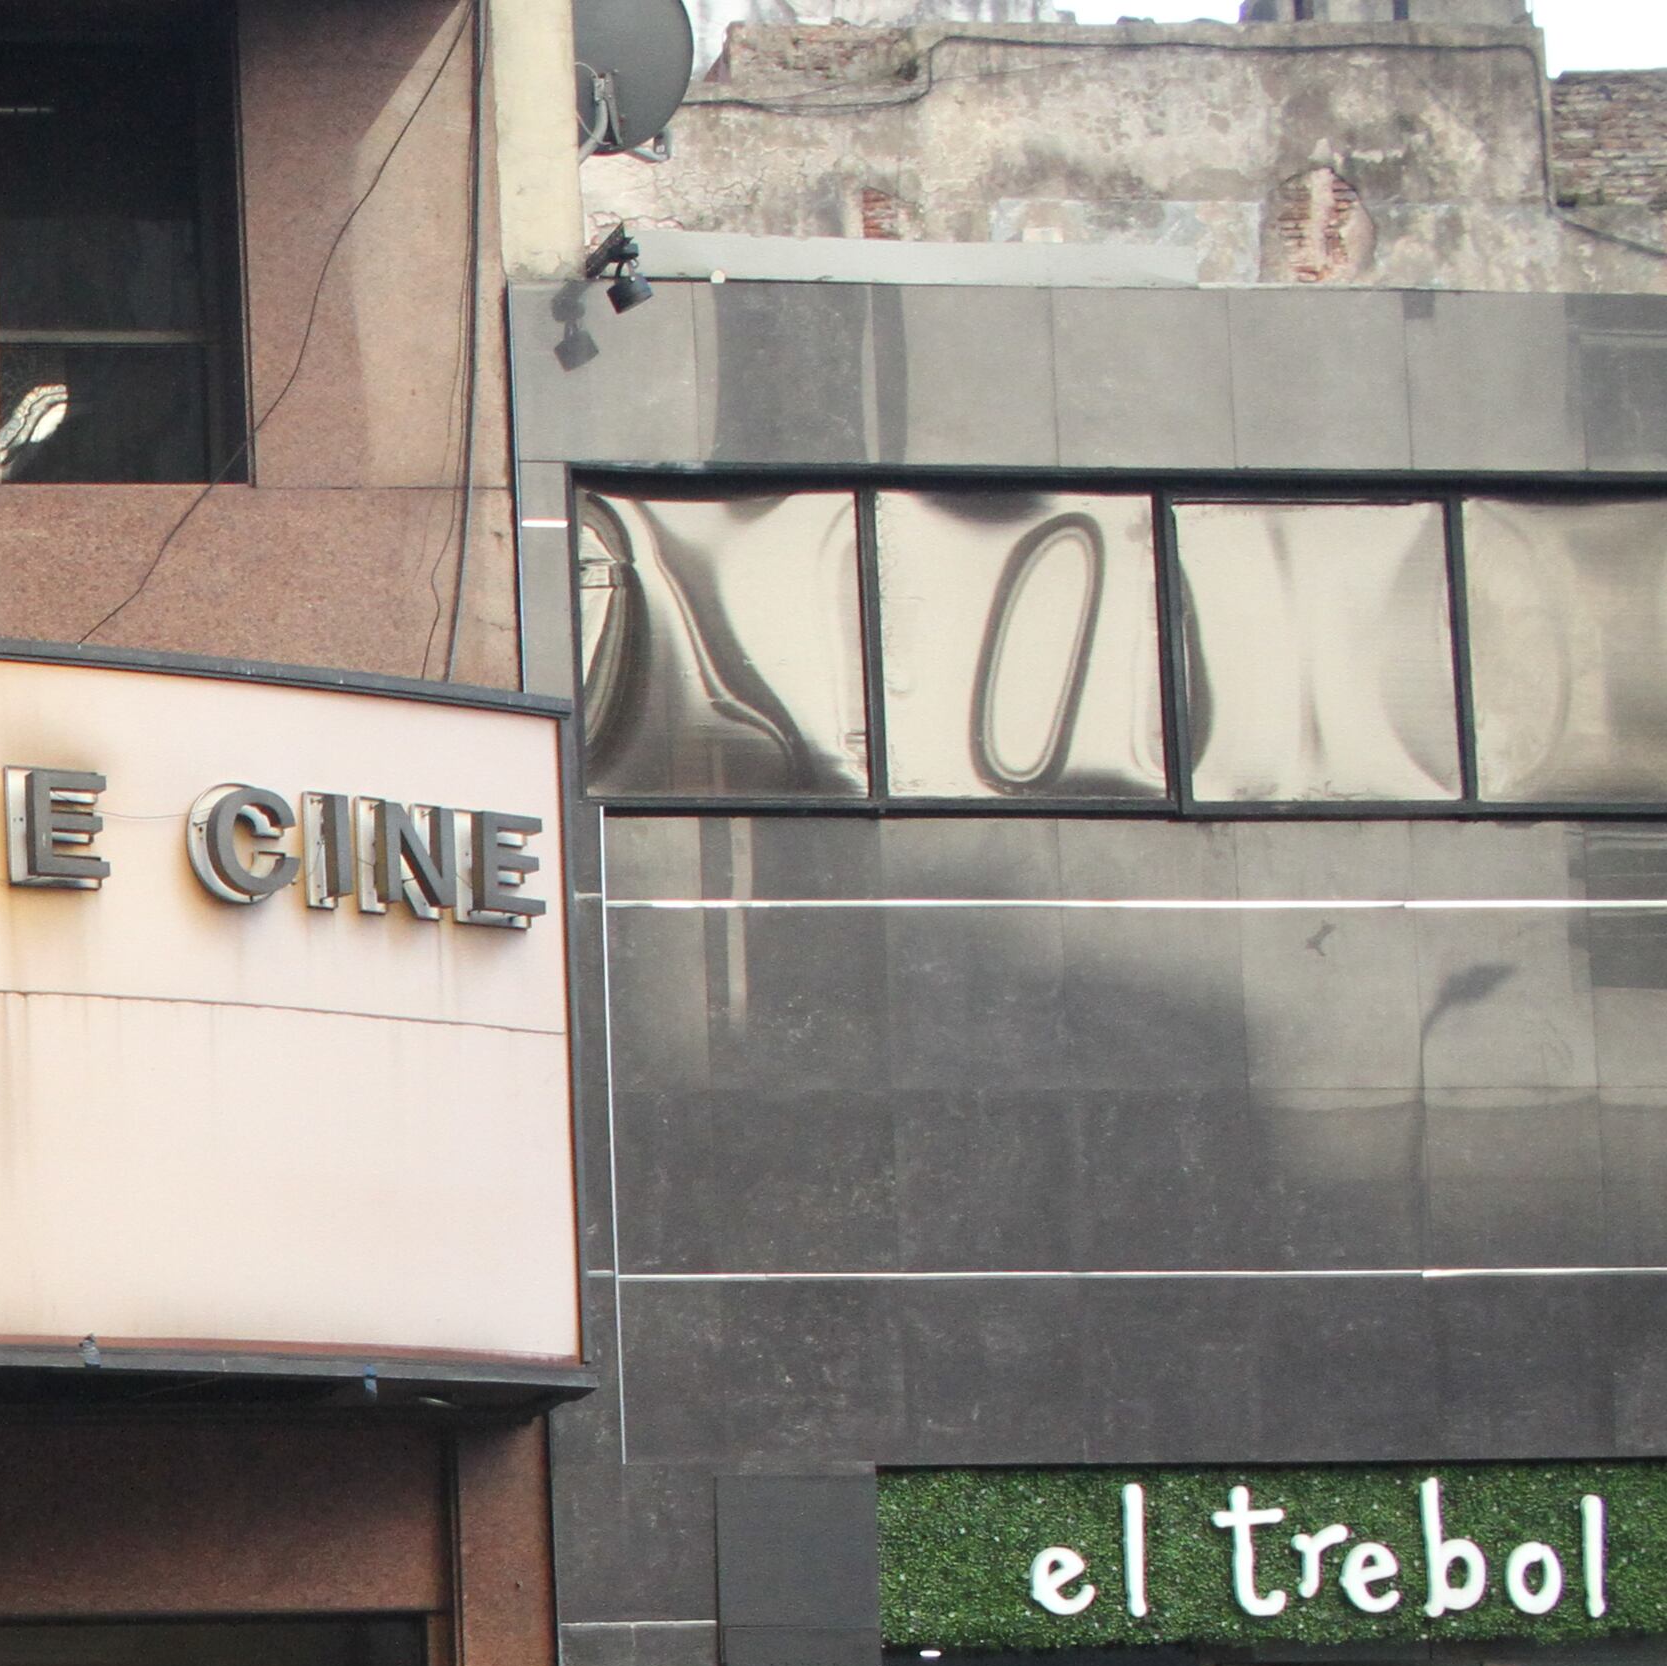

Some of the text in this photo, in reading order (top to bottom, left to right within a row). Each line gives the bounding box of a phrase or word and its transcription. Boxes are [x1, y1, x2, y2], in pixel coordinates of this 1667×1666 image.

[186, 782, 547, 931] CINE
[1031, 1476, 1608, 1618] el trebol
